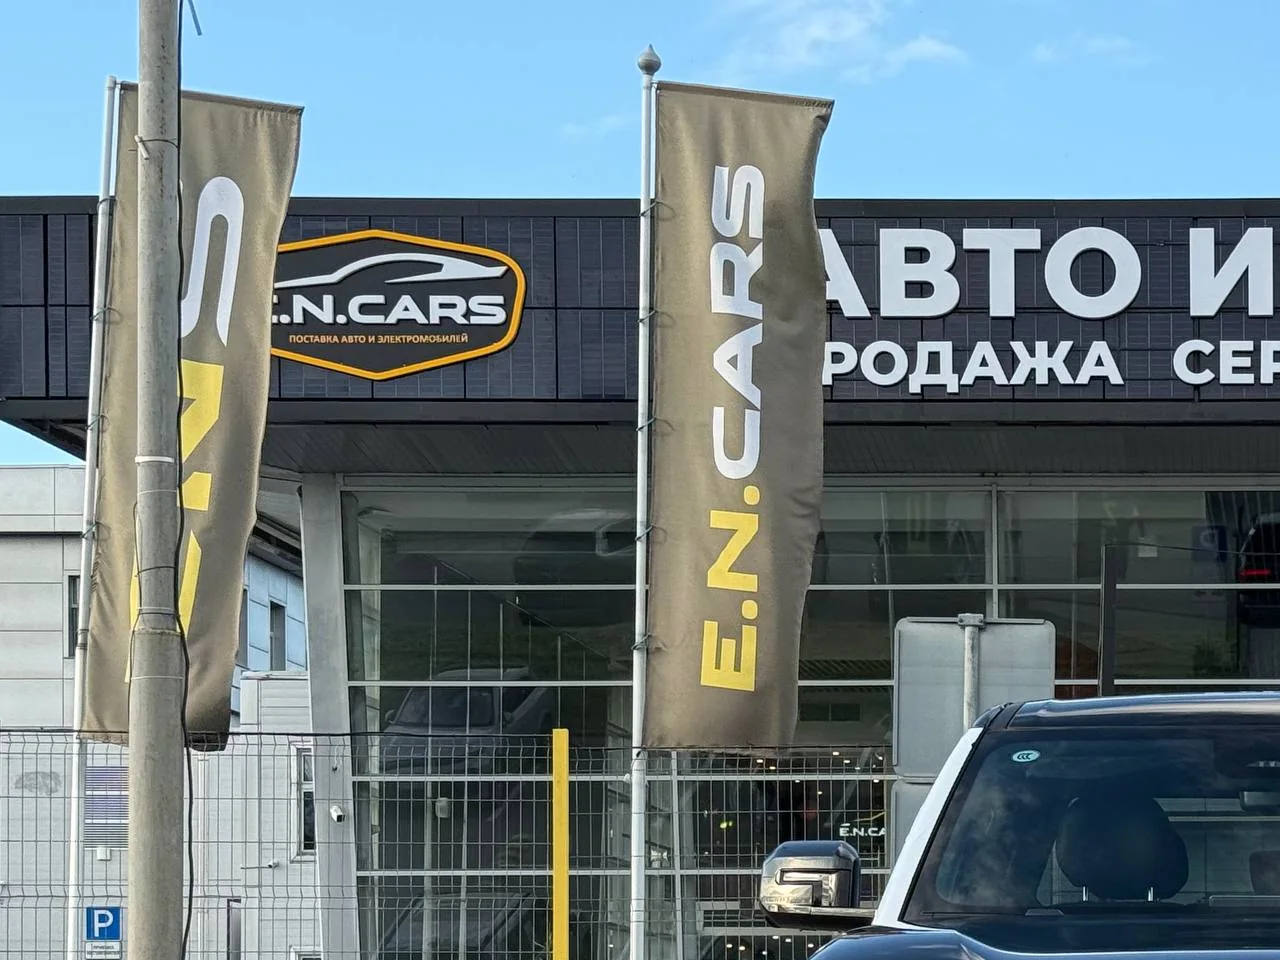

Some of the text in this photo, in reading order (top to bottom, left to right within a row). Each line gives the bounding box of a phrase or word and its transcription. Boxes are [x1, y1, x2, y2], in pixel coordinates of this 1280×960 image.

[272, 294, 507, 325] .N.CARS
[289, 333, 469, 344] ПОСТАВКА АВТО И ЭЛЕКТРОМОБИЛЕЙ
[822, 341, 1125, 394] РОДАЖА
[700, 164, 765, 692] E.N.CARS
[839, 827, 887, 837] E.N.CA
[93, 909, 114, 938] P
